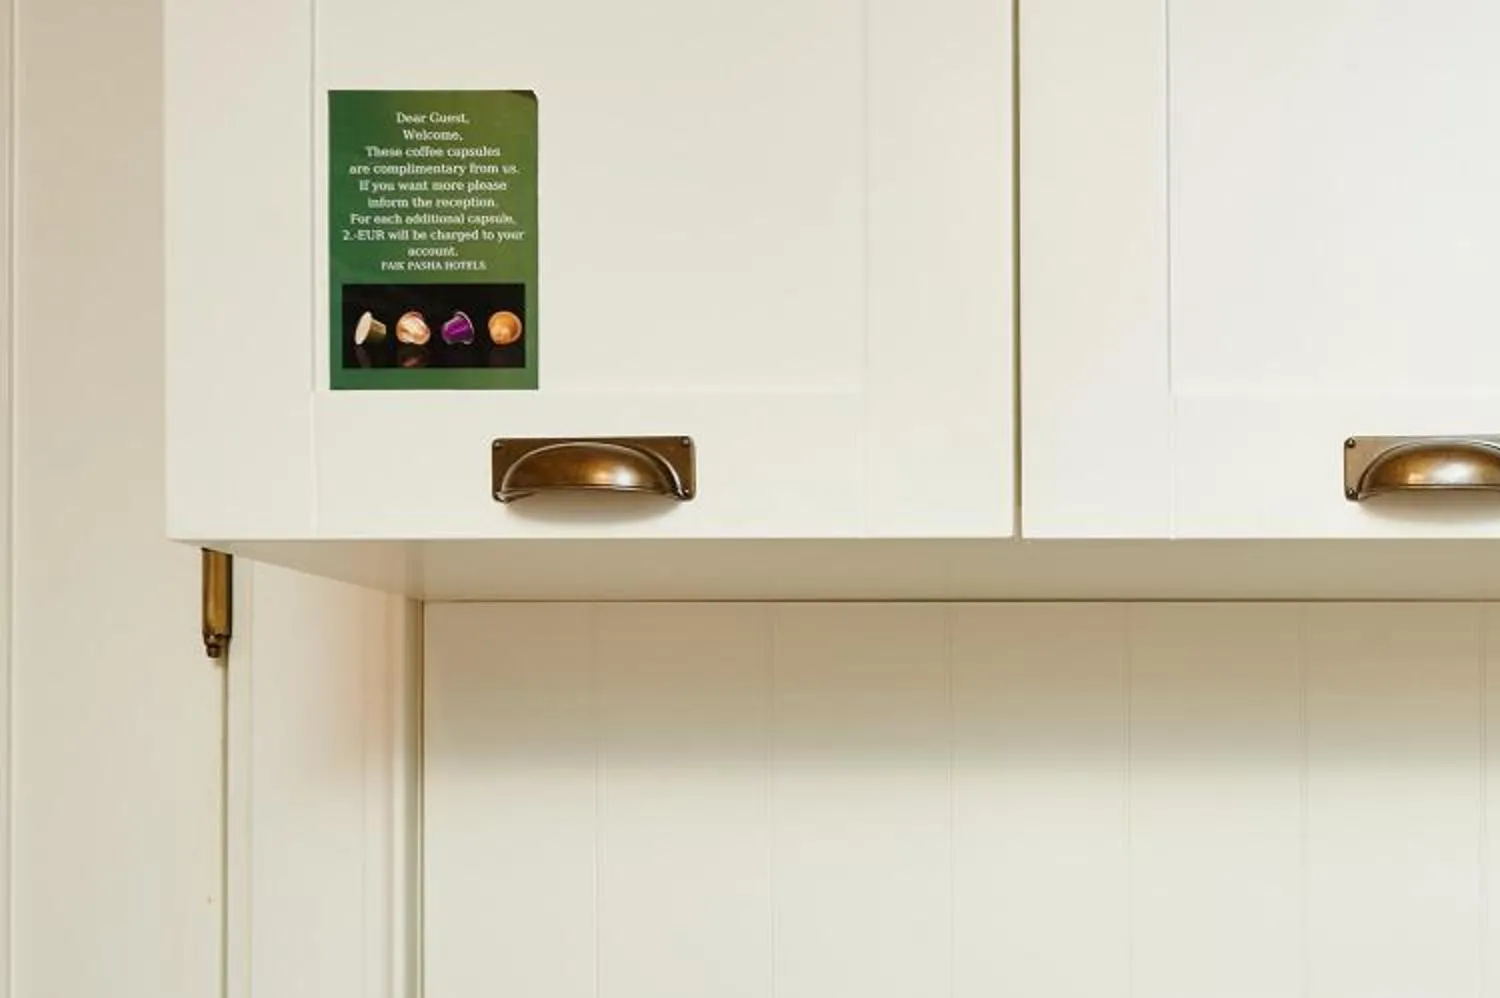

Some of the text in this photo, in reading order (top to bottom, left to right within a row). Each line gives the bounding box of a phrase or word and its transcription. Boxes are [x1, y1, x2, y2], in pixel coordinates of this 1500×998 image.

[396, 112, 427, 124] Dear
[365, 145, 501, 160] These coffee capsules
[349, 162, 519, 177] are complimentary from us.
[359, 179, 507, 193] If you want more please
[368, 196, 498, 210] inform the reception.
[350, 213, 370, 224] For
[373, 213, 403, 224] each
[405, 213, 465, 225] additional
[387, 229, 409, 240] will
[411, 229, 427, 240] be
[429, 229, 479, 243] charged
[482, 230, 495, 240] to
[497, 231, 524, 243] your
[408, 247, 457, 257] account.
[407, 260, 443, 270] PASHA
[444, 260, 486, 270] HOTELS
